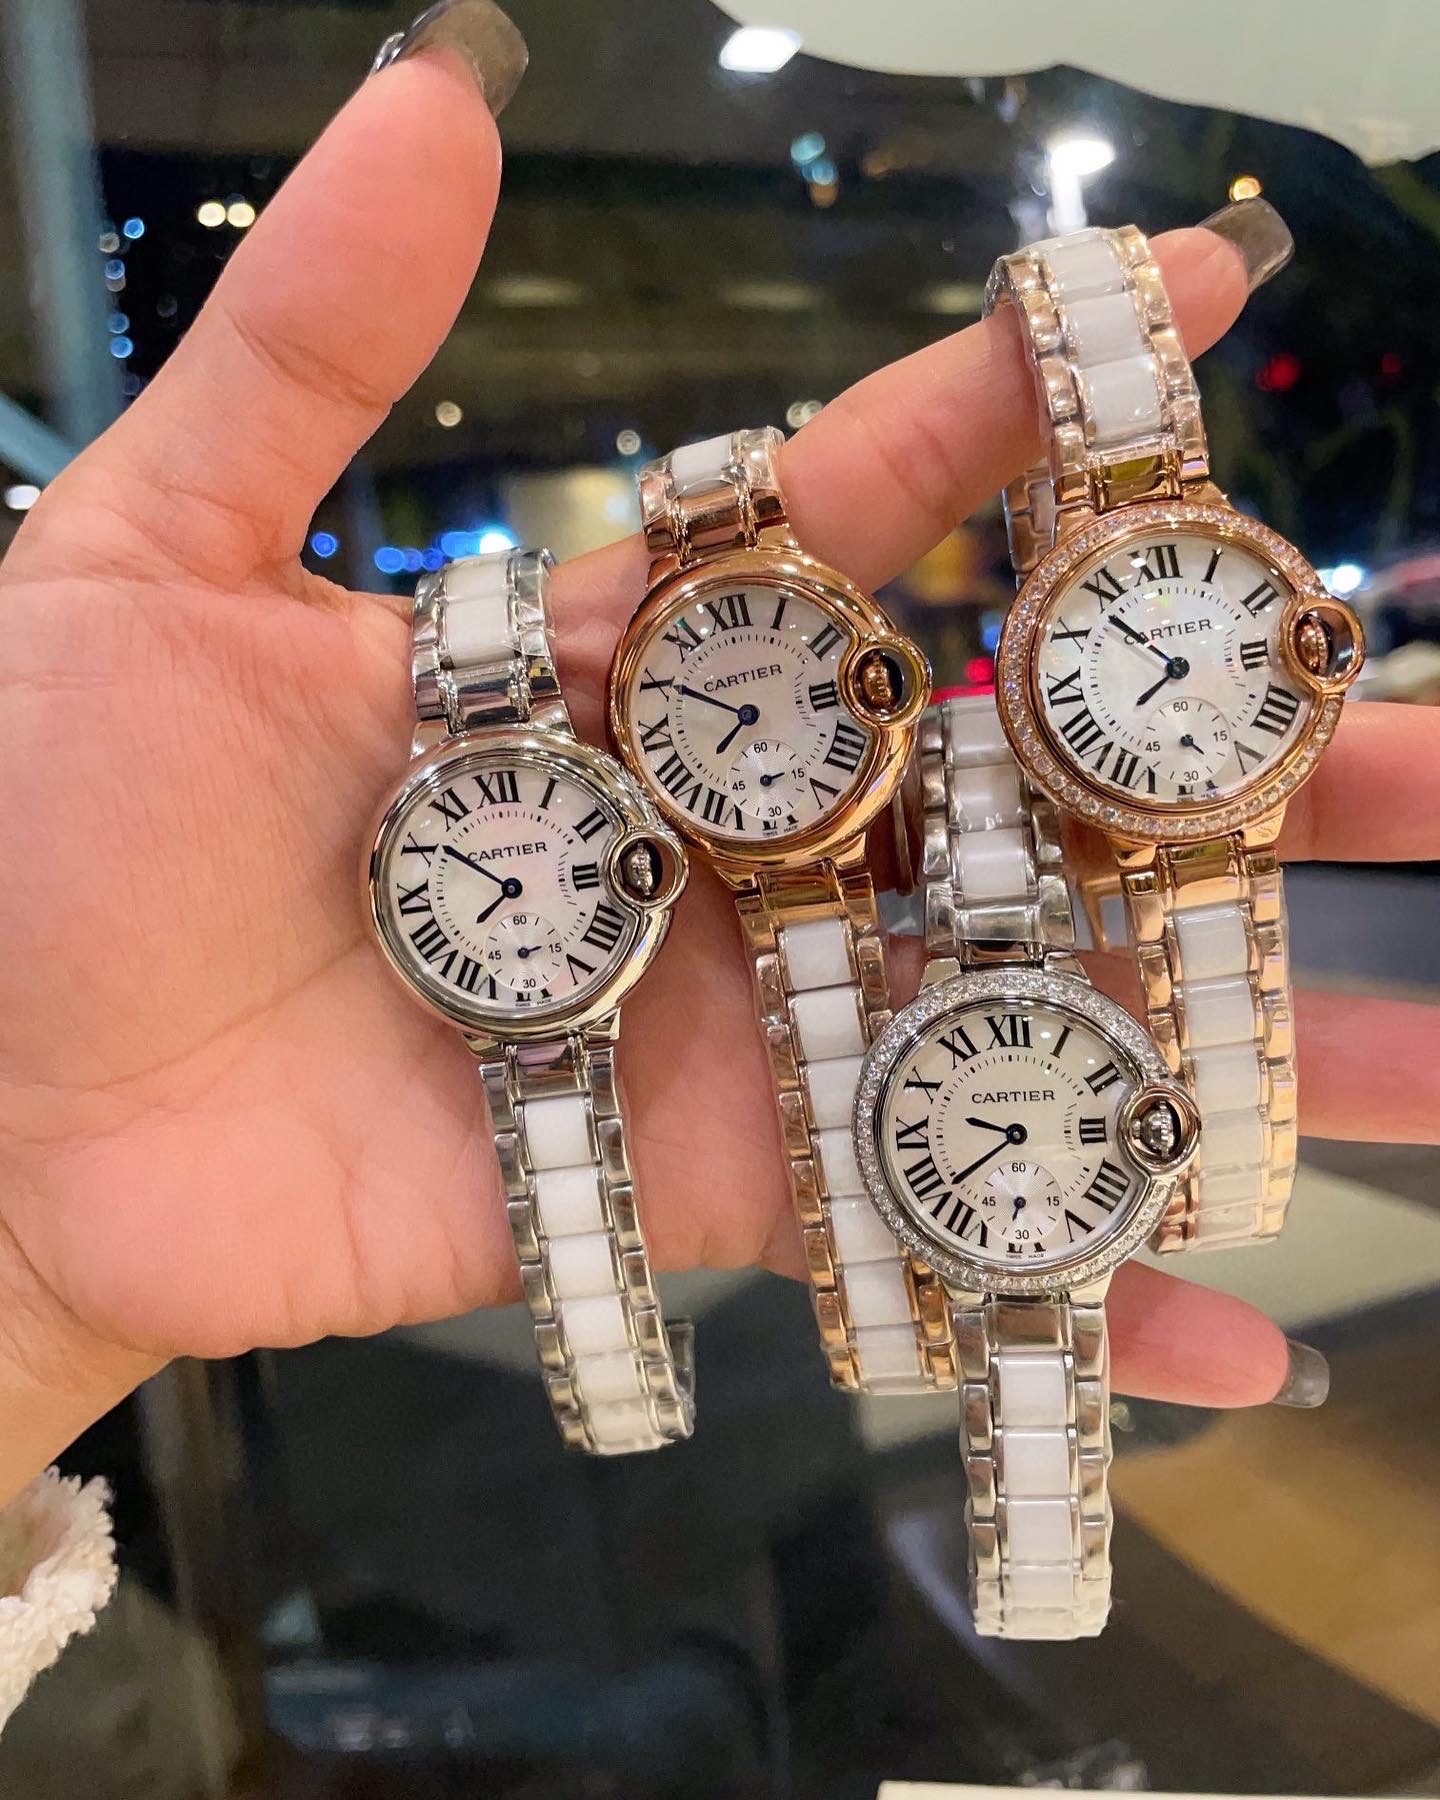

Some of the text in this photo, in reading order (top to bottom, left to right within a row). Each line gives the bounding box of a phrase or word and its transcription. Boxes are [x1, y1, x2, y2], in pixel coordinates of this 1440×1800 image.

[1128, 544, 1183, 587] XII
[1080, 566, 1129, 614] XI
[1240, 579, 1280, 618] II
[704, 593, 753, 636] XII
[662, 617, 706, 664] XI
[806, 622, 844, 661] II
[1050, 617, 1092, 653] X
[1240, 638, 1271, 671] III
[639, 667, 675, 702] X
[703, 664, 783, 693] CARTIER
[808, 679, 839, 712] III
[1046, 666, 1086, 709] IX
[1173, 701, 1189, 712] 60
[1250, 682, 1299, 740] IIII
[638, 714, 676, 755] IX
[753, 742, 768, 753] 60
[823, 720, 868, 775] IIII
[1059, 705, 1114, 771] VIII
[1145, 741, 1161, 752] 45
[1213, 730, 1228, 742] 15
[792, 768, 805, 779] 15
[1234, 740, 1267, 776] V
[473, 770, 522, 809] XII
[654, 751, 703, 813] VIII
[731, 780, 746, 792] 45
[809, 777, 841, 810] V
[1183, 770, 1199, 782] 30
[428, 787, 472, 831] XI
[572, 807, 610, 843] II
[768, 805, 782, 817] 30
[400, 832, 439, 867] X
[467, 841, 548, 863] CARTIER
[572, 861, 600, 892] III
[397, 879, 432, 917] IX
[513, 915, 527, 926] 60
[580, 901, 626, 954] IIII
[409, 915, 459, 979] VIII
[488, 950, 501, 961] 45
[549, 943, 562, 953] 15
[522, 978, 536, 989] 30
[565, 953, 597, 985] V
[936, 1025, 981, 1070] XI
[984, 1014, 1033, 1050] XII
[903, 1066, 943, 1104] X
[1083, 1060, 1123, 1096] II
[971, 1089, 1056, 1104] CARTIER
[896, 1115, 931, 1151] IX
[1079, 1117, 1107, 1145] III
[1011, 1162, 1026, 1173] 60
[903, 1153, 953, 1220] VIII
[981, 1197, 996, 1207] 45
[1047, 1197, 1060, 1207] 15
[1082, 1158, 1131, 1214] IIII
[1015, 1229, 1030, 1240] 30
[1065, 1209, 1095, 1243] V
